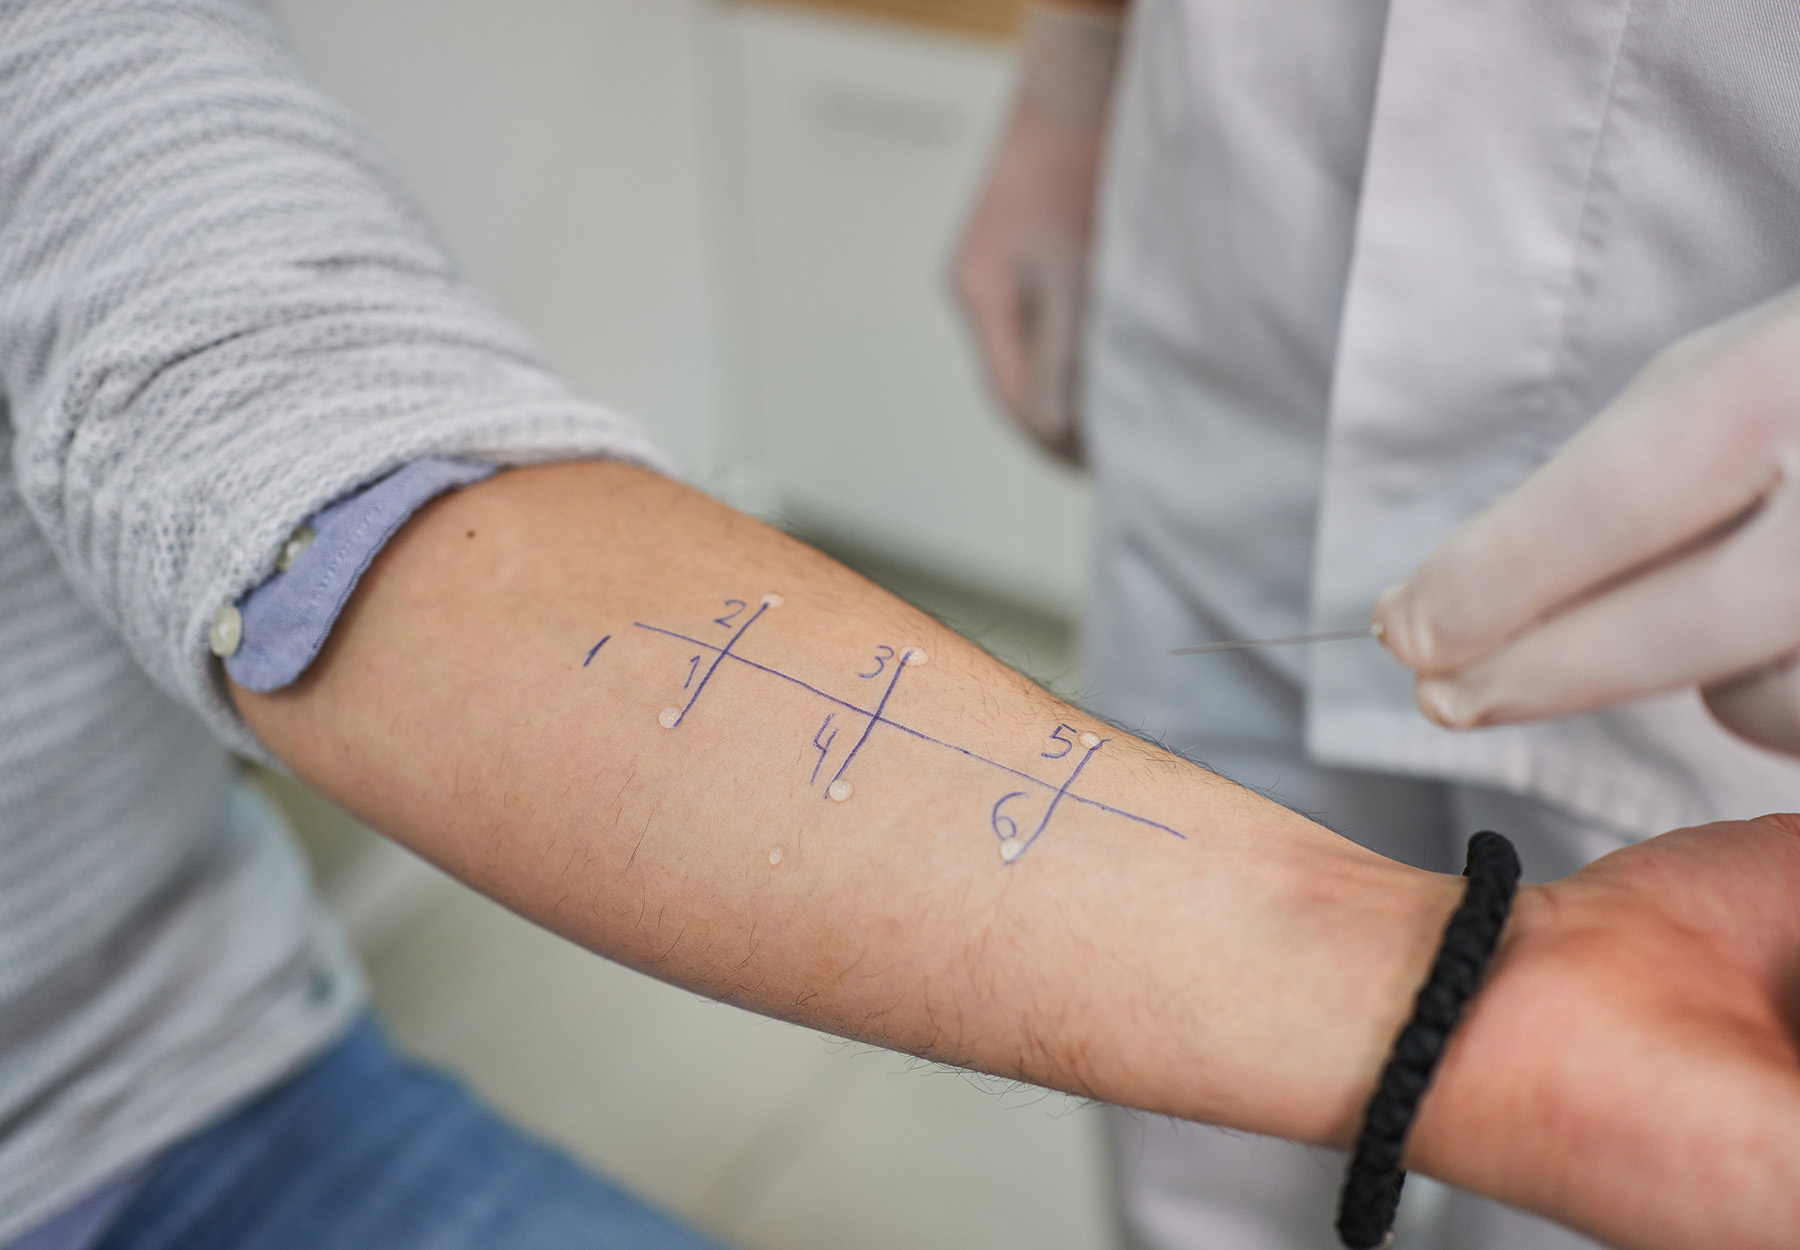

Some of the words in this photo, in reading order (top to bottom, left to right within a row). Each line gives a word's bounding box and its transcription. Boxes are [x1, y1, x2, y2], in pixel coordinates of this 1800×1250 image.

[713, 600, 747, 628] 2
[683, 654, 701, 690] 1
[858, 645, 895, 679] 3
[810, 712, 839, 786] 4
[1041, 723, 1078, 759] 5
[991, 791, 1031, 842] 6
